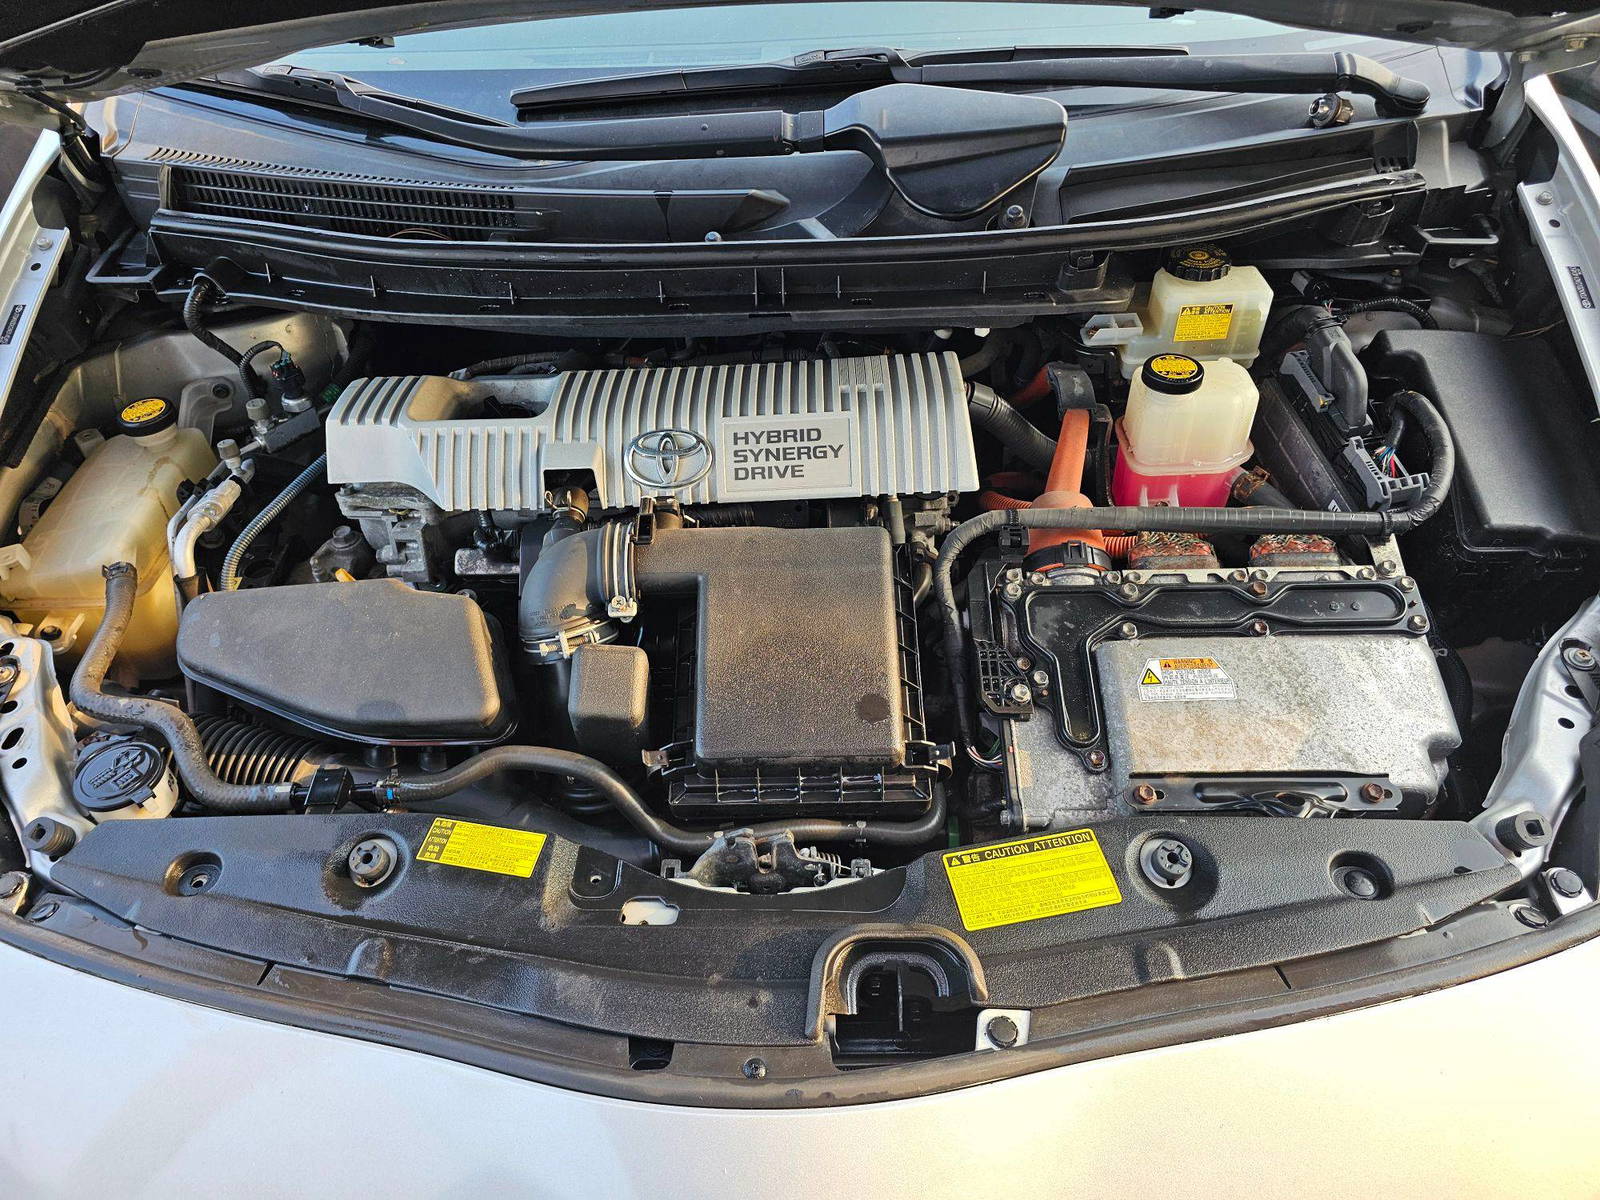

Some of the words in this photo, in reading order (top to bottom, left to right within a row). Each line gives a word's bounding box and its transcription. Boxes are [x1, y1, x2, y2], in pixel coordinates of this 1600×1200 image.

[733, 428, 822, 446] HYBRID
[733, 444, 844, 463] SYNERGY
[734, 464, 805, 481] DRIVE
[984, 844, 1030, 860] CAUTION
[1033, 833, 1091, 852] ATTENTION
